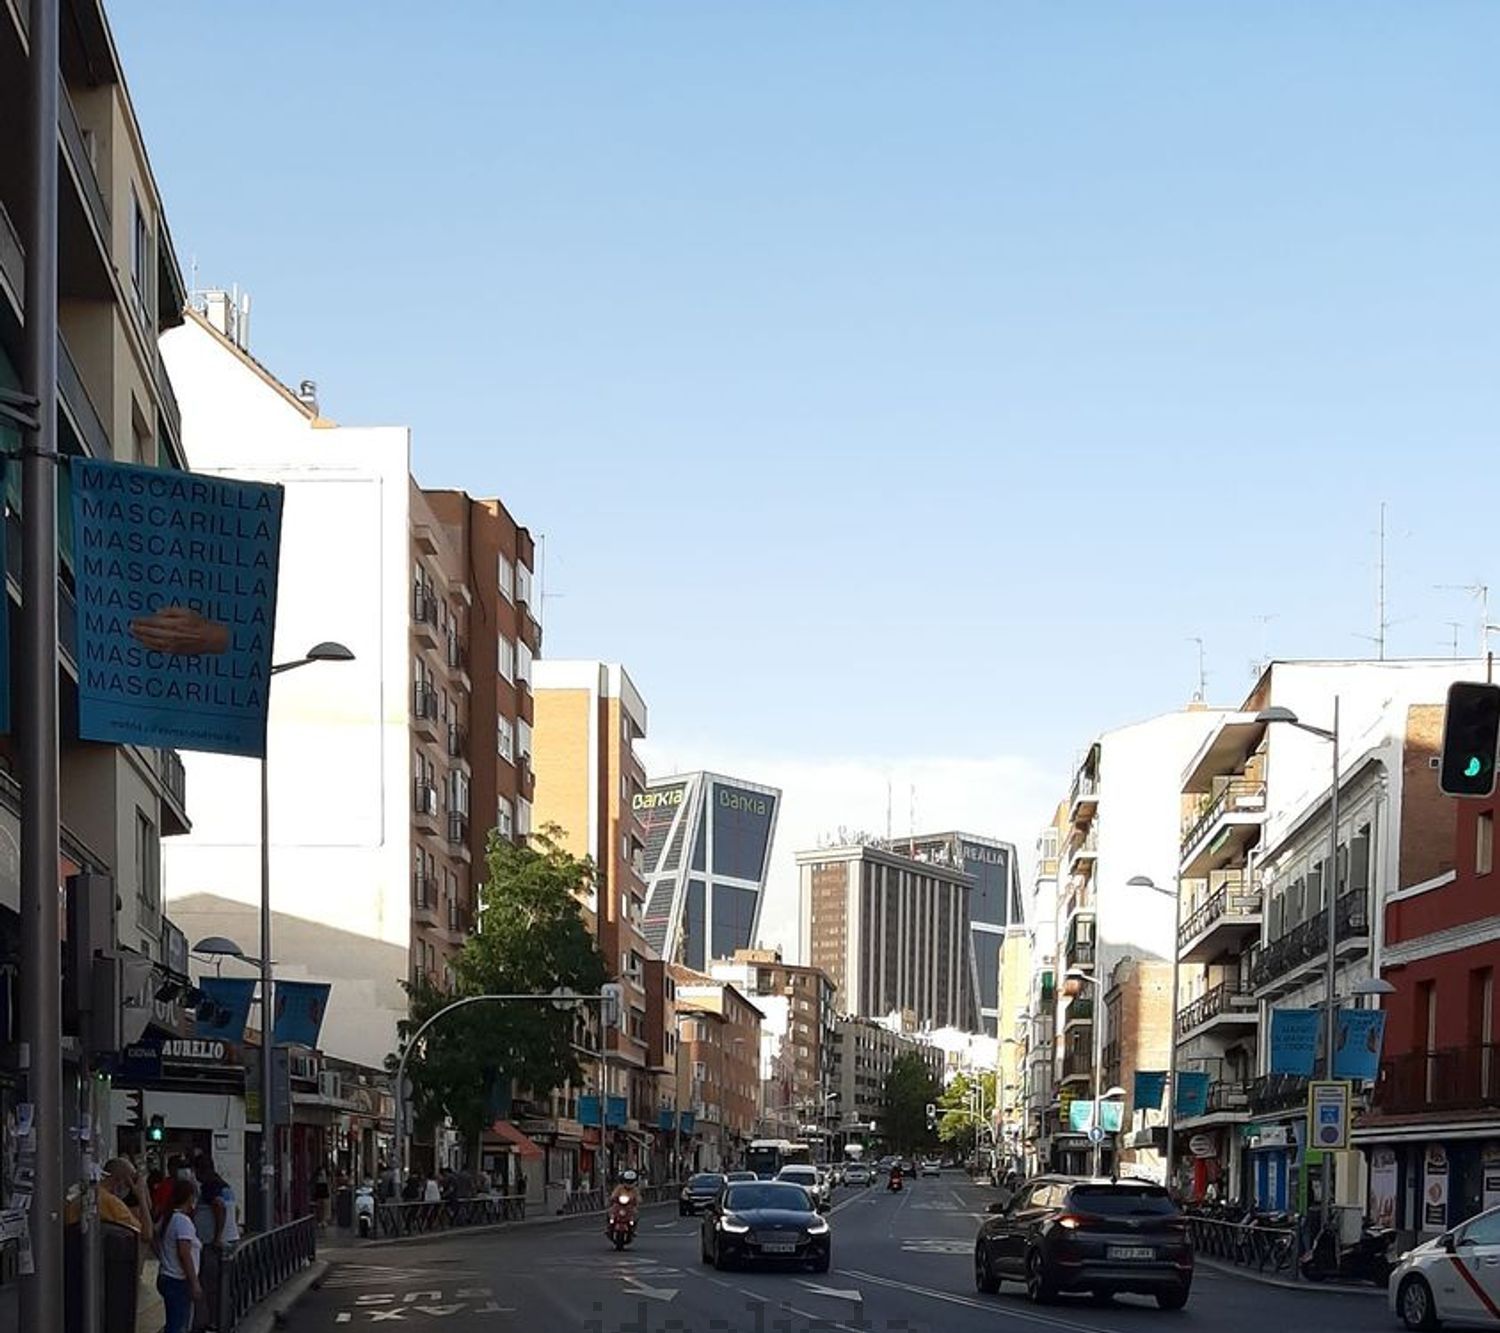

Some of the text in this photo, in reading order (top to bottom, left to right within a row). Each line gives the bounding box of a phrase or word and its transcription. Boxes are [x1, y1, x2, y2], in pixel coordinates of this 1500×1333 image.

[82, 468, 271, 512] MASCARILLA
[83, 498, 271, 541] MASCARILLA
[83, 526, 270, 568] MASCARILLA
[84, 555, 267, 598] MASCARILLA
[86, 640, 262, 680] MASCARILLA
[87, 668, 261, 708] MASCARILLA
[633, 789, 683, 810] Bankia
[719, 789, 766, 814] Bankia
[963, 846, 1004, 866] REALIA
[161, 1039, 224, 1059] AURELIO
